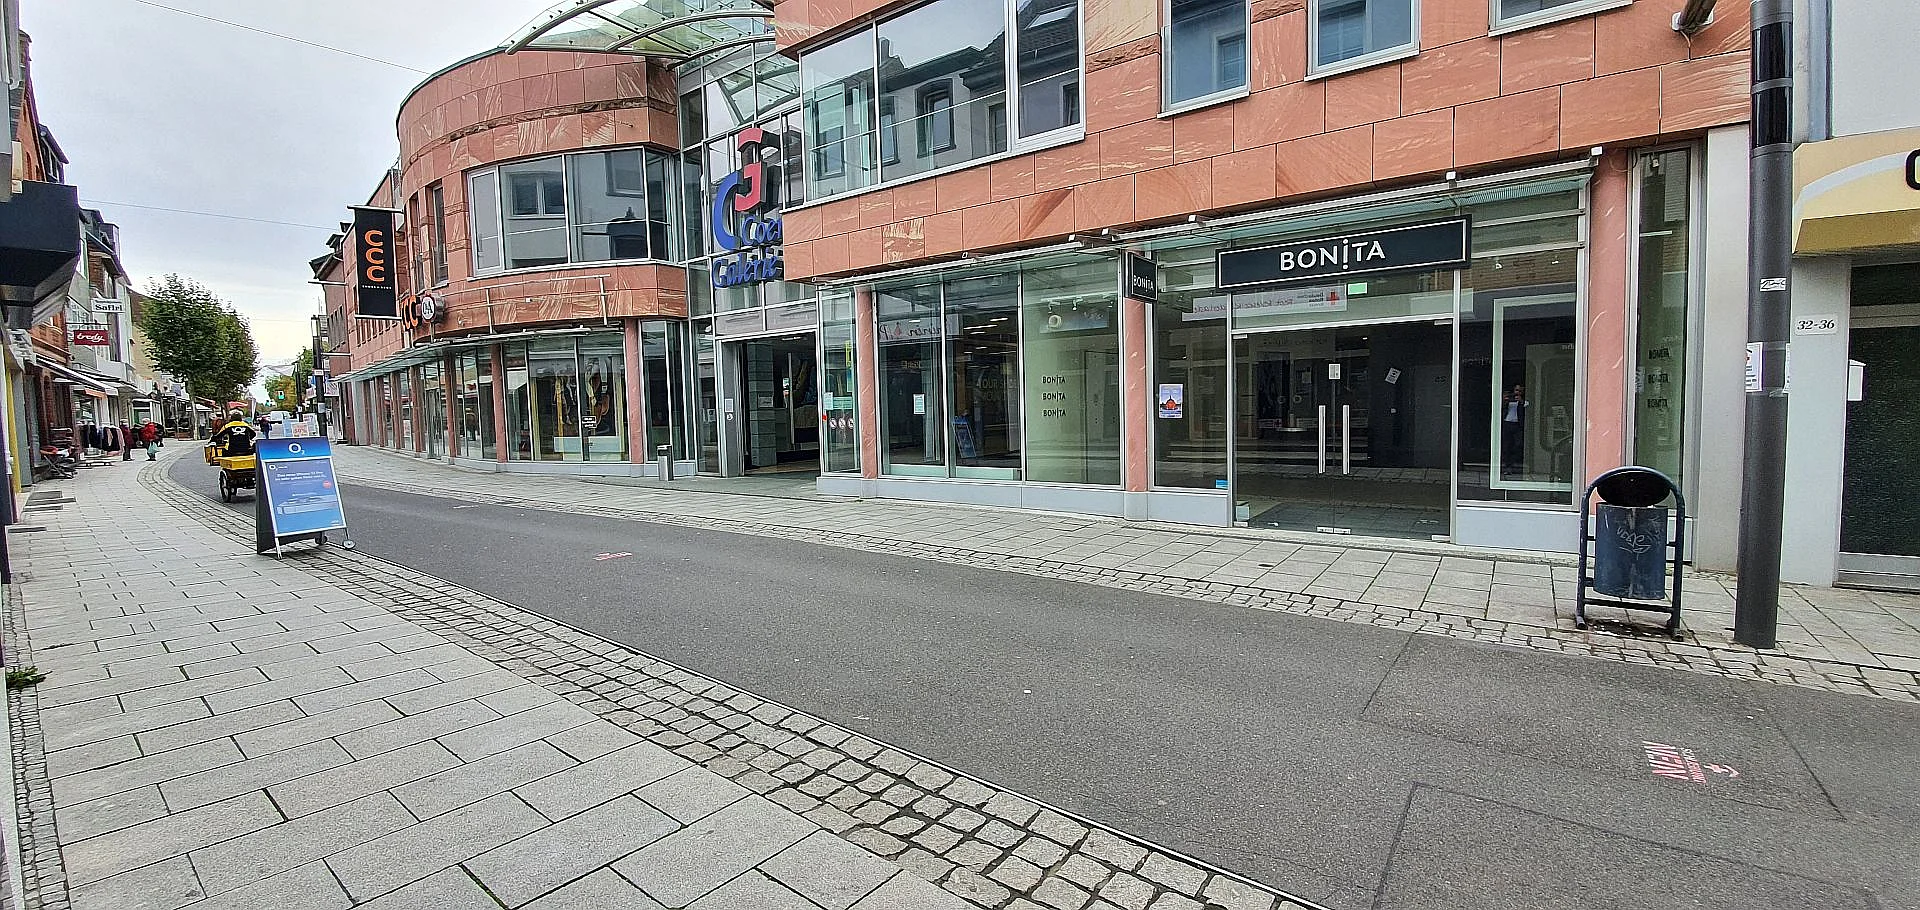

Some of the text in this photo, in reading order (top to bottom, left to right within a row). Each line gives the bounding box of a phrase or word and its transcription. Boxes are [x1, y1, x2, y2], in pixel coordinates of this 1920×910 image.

[1280, 239, 1386, 271] BONITA
[712, 247, 779, 288] Galerie
[1133, 274, 1155, 293] BONITA
[1797, 319, 1836, 331] 32-36
[1042, 374, 1066, 387] BONITA
[1042, 390, 1066, 403] BONITA
[1043, 407, 1067, 420] BONITA
